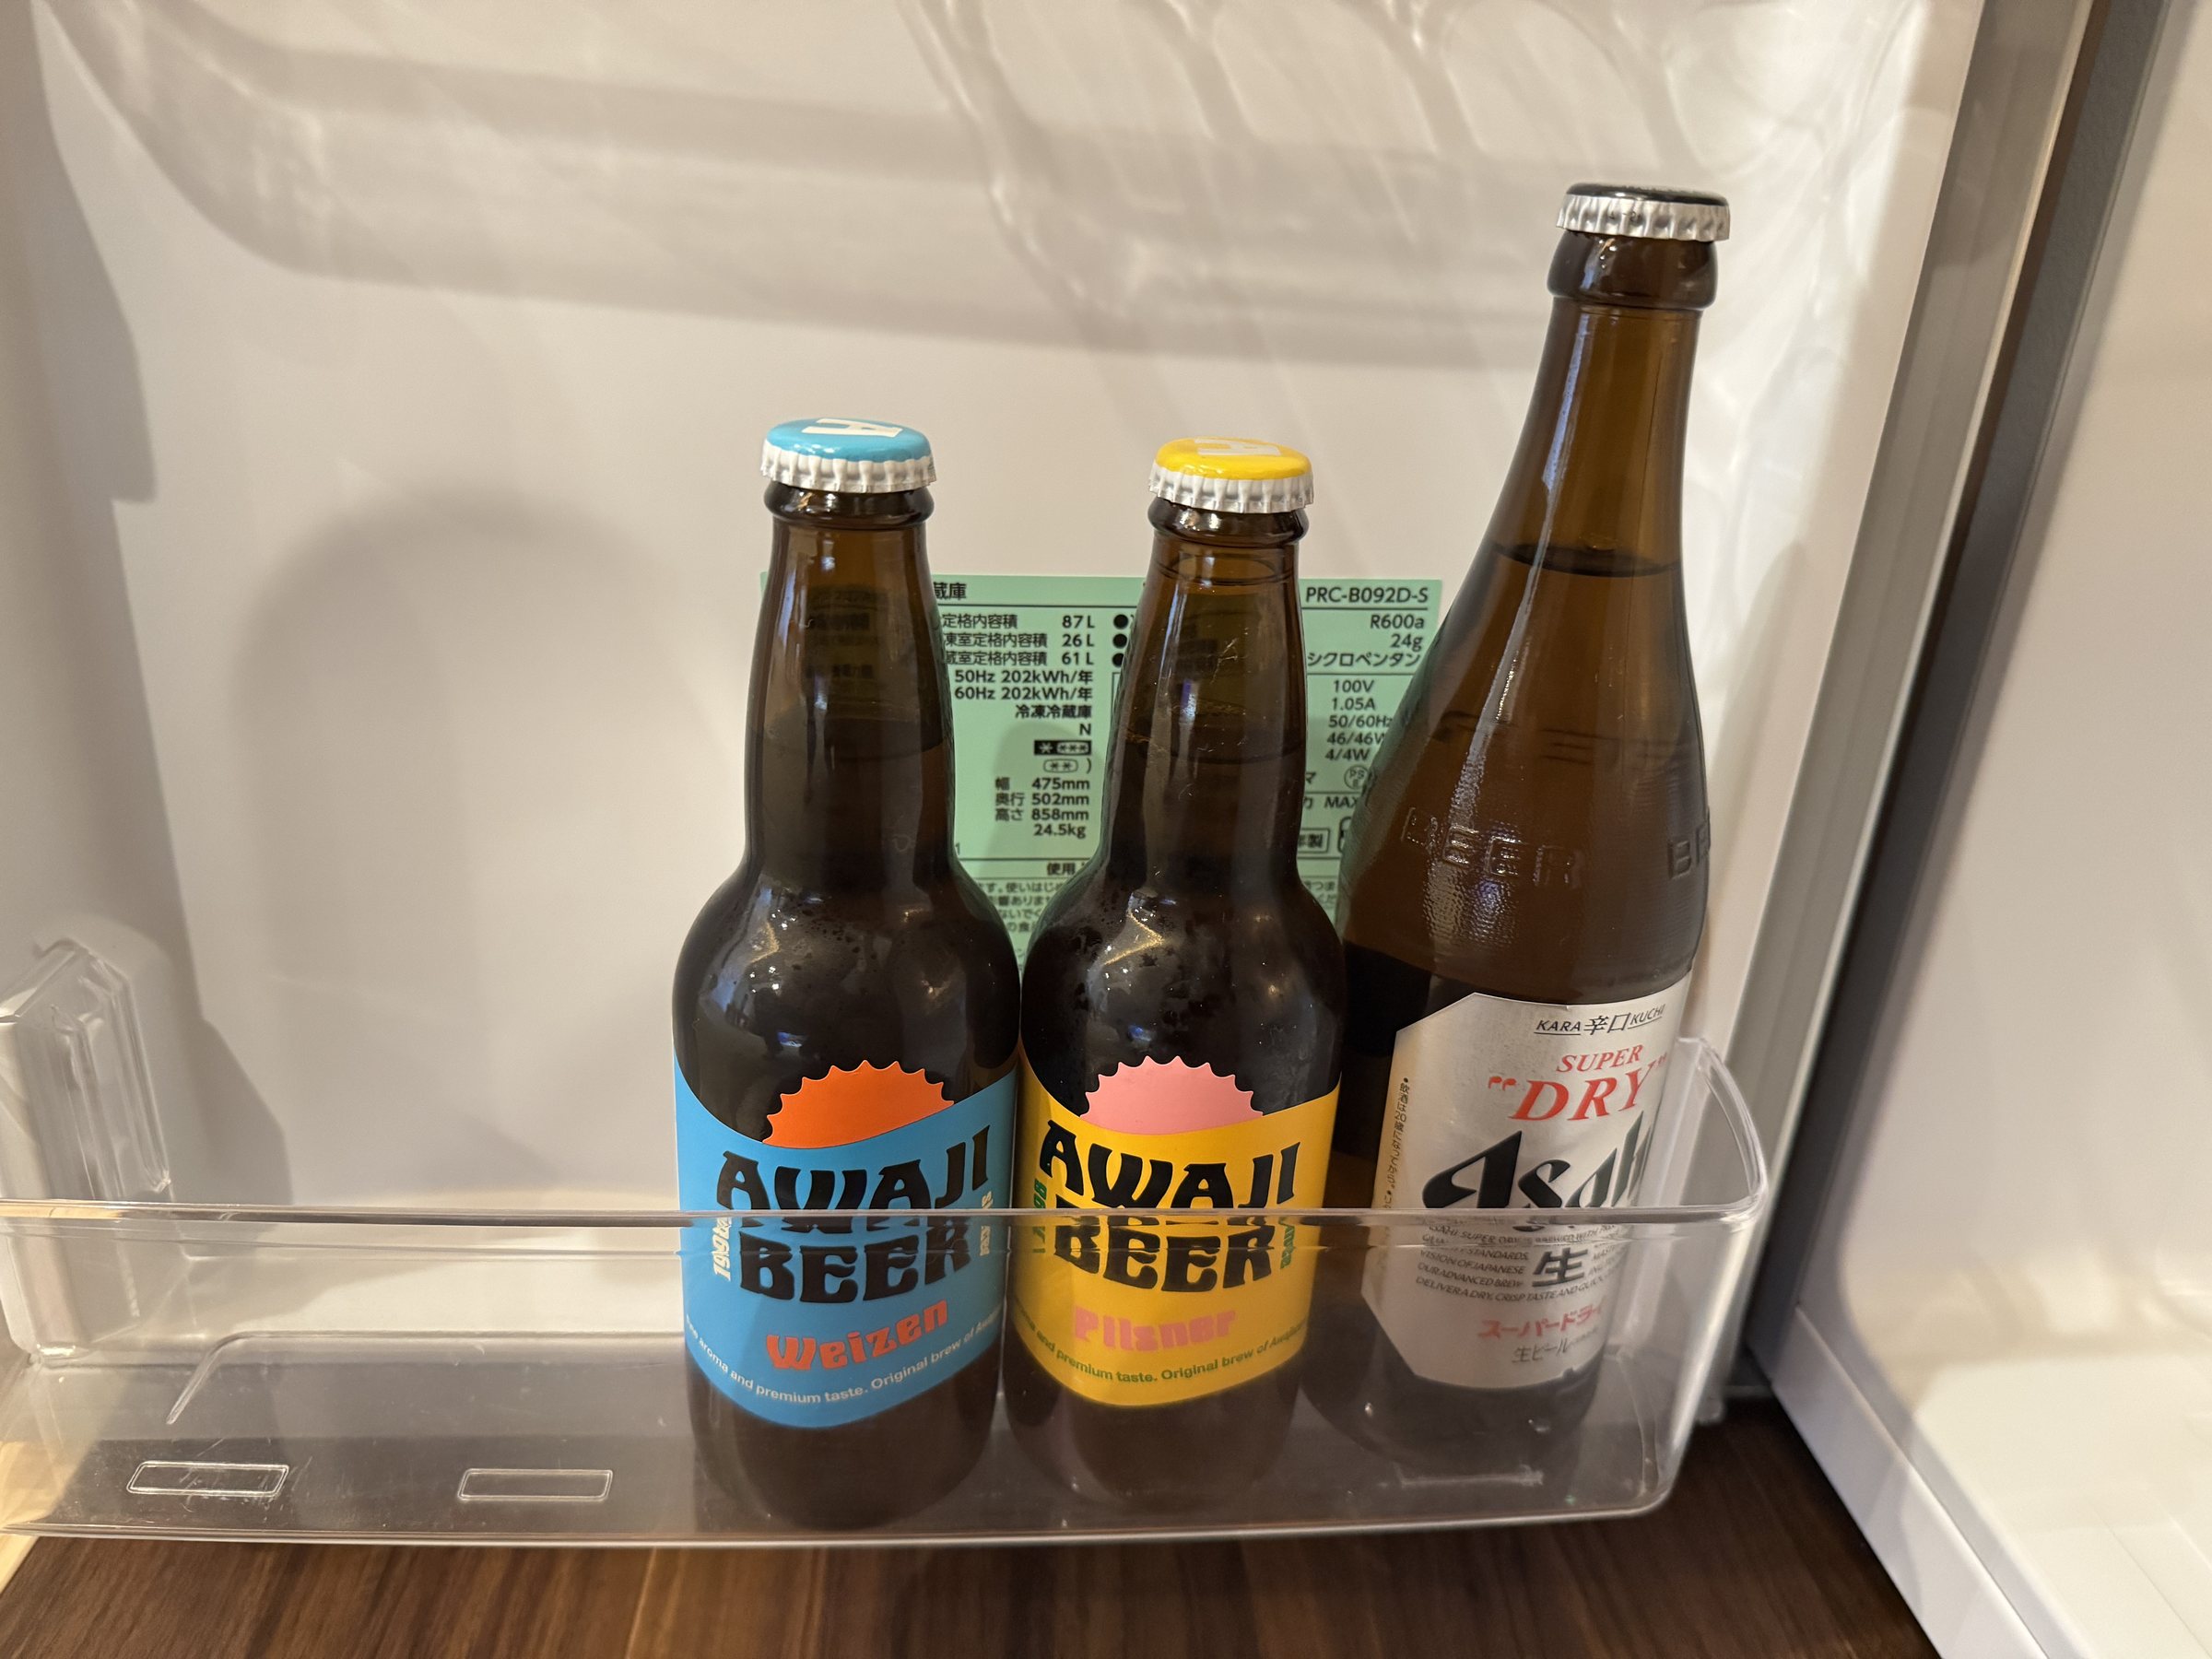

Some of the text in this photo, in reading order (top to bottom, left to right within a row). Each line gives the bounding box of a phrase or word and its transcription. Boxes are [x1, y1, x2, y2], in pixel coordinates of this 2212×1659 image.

[1305, 587, 1429, 603] PRC-B092D-S
[1370, 614, 1425, 629] R600a
[1390, 633, 1424, 653] 24g
[1307, 652, 1421, 666] シクロペンタン
[955, 669, 1093, 685] 50Hz 202kWh/年
[955, 687, 1093, 701] 60Hz 202kWh/年
[1334, 680, 1375, 693] 100V
[1016, 705, 1092, 719] 冷凍冷蔵庫
[1332, 698, 1376, 711] 1.05A
[1079, 724, 1092, 735] N
[1324, 748, 1371, 761] 4/4W
[1031, 777, 1090, 791] 475mm
[1031, 793, 1090, 806] 502mm
[1031, 808, 1089, 820] 858mm
[1033, 824, 1087, 839] 24.5kg
[1536, 1019, 1581, 1031] KARA
[1556, 1044, 1643, 1073] SUPER
[1039, 1119, 1301, 1209] AWAJI
[1422, 1111, 1653, 1210] Asah
[716, 1124, 992, 1230] AWAJI
[1054, 1213, 1276, 1292] BEER
[739, 1220, 971, 1303] BEER
[1532, 1247, 1588, 1288] 生
[766, 1299, 949, 1371] Weizen
[1074, 1304, 1237, 1353] Pilsner
[699, 1336, 729, 1374] aroma
[731, 1370, 754, 1390] and
[756, 1384, 821, 1404] premium
[825, 1386, 868, 1402] taste.
[870, 1357, 928, 1390] Original
[931, 1338, 961, 1364] brew
[1056, 1349, 1113, 1381] premium
[1116, 1371, 1158, 1383] taste.
[1160, 1359, 1219, 1381] Original
[1221, 1348, 1254, 1368] brew
